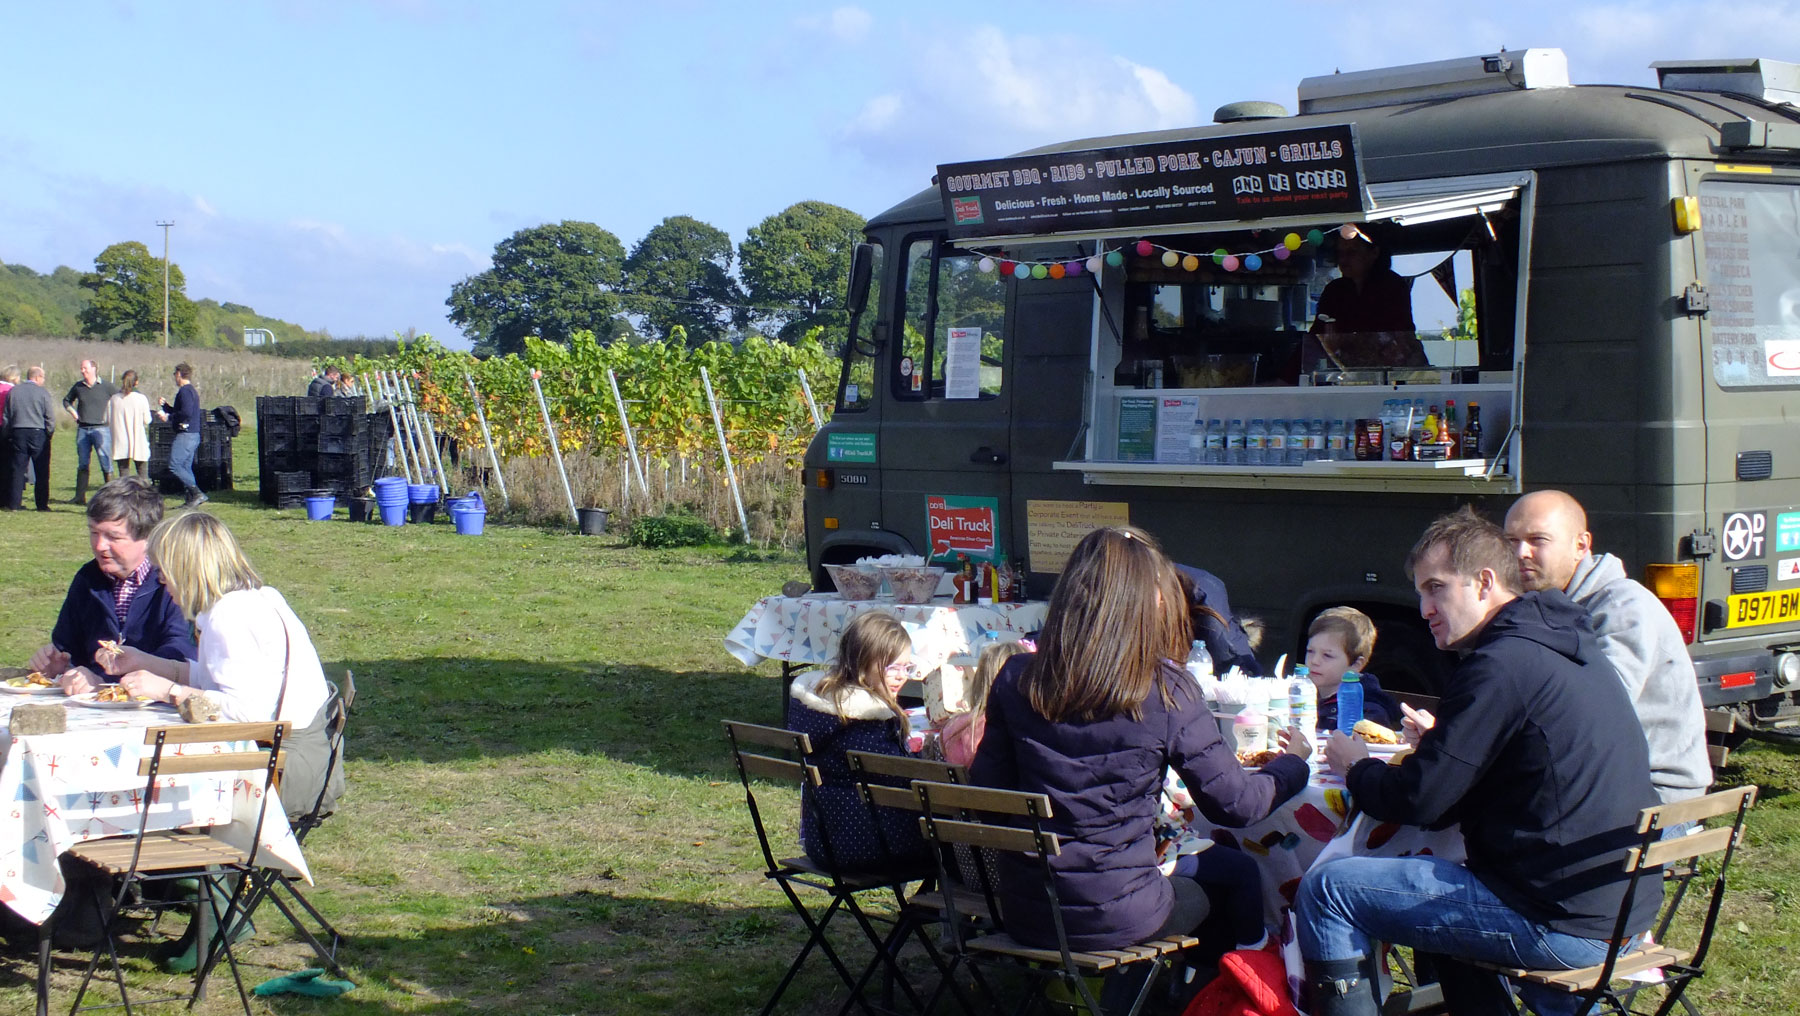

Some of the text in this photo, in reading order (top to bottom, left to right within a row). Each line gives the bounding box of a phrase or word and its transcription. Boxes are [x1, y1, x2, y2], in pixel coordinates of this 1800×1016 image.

[947, 140, 1343, 192] GOURMET BBQ RIBS PULLED PORK CAJUN GRILLS
[1233, 169, 1348, 194] AND WE CATER
[995, 182, 1214, 211] Delicious Fresh Home Made Locally Sourced
[1028, 510, 1060, 518] Corporate
[1060, 511, 1079, 519] Event
[1079, 502, 1098, 511] Party
[930, 515, 992, 533] Deli Truck
[1753, 513, 1766, 534] D
[1037, 530, 1060, 538] Private
[1753, 536, 1764, 556] T
[1738, 596, 1776, 622] D971
